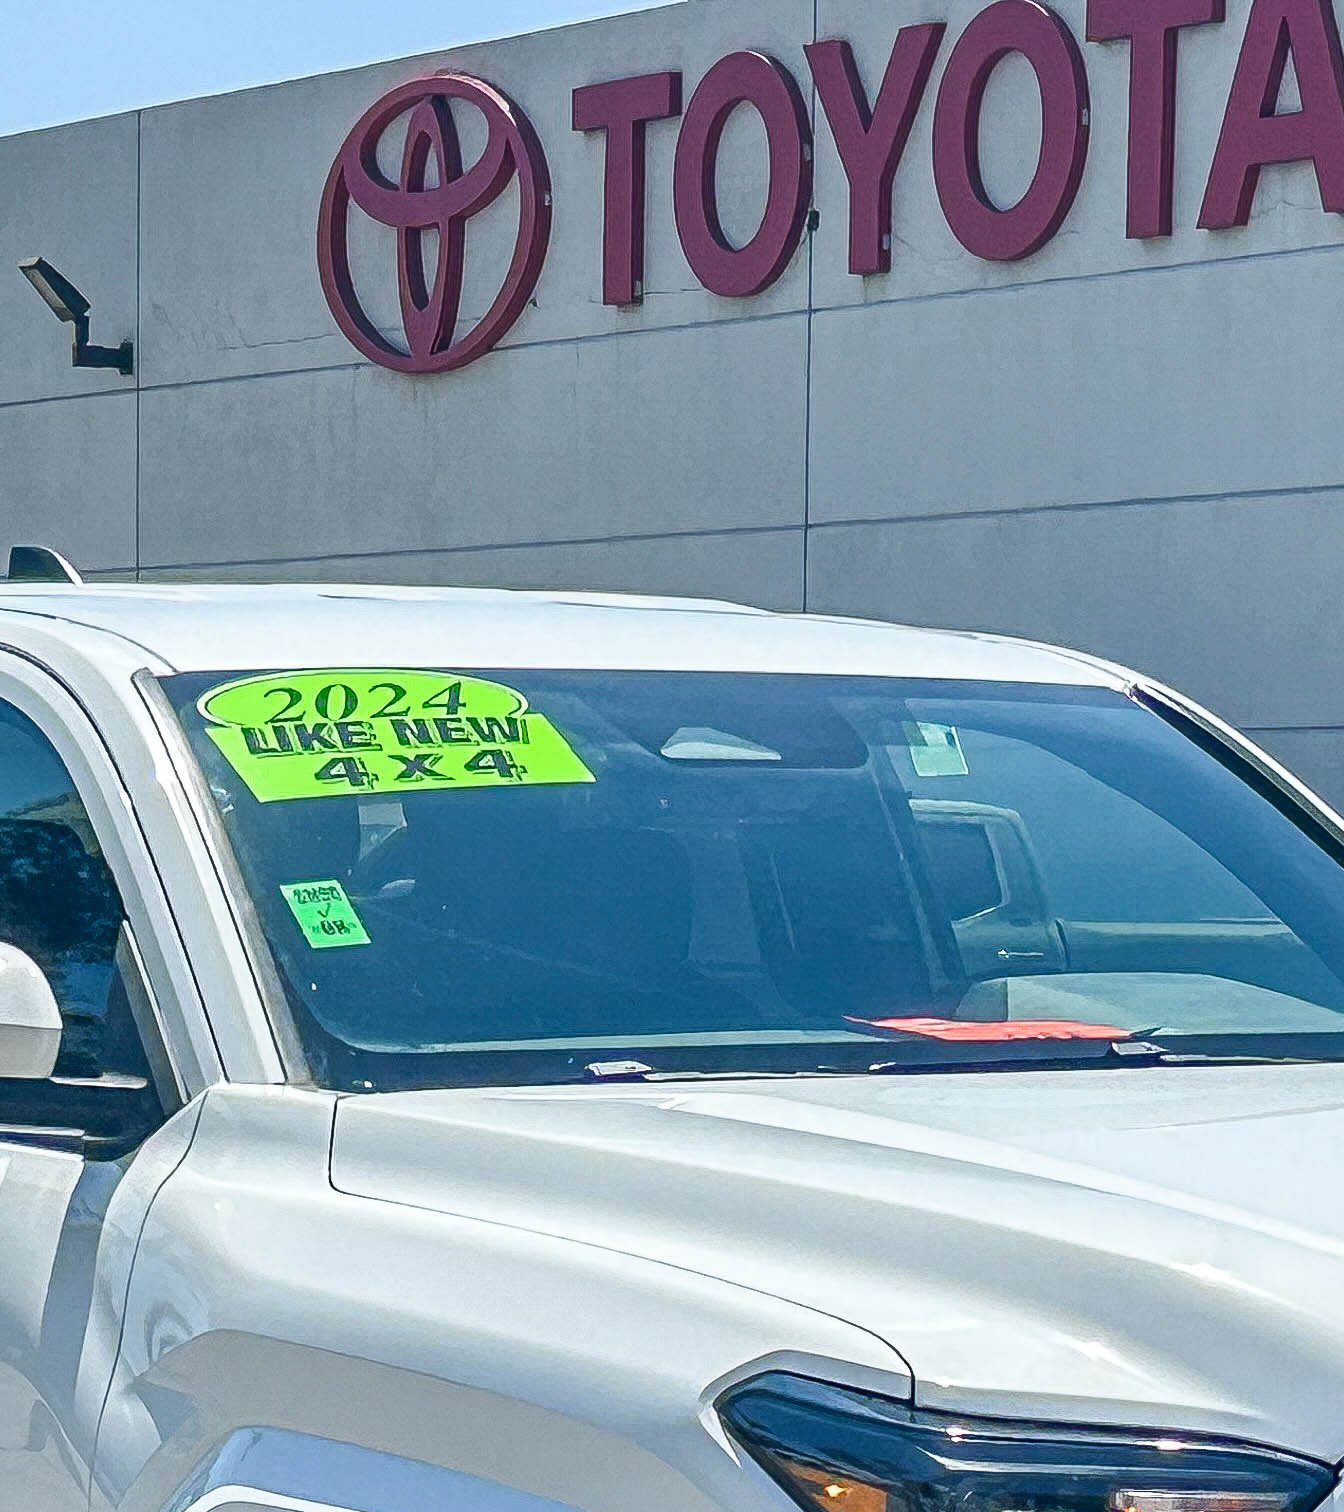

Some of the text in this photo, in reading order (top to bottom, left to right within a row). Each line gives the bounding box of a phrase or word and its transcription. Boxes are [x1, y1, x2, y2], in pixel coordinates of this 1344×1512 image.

[262, 681, 467, 725] 2024
[241, 715, 530, 758] LIKE NEW
